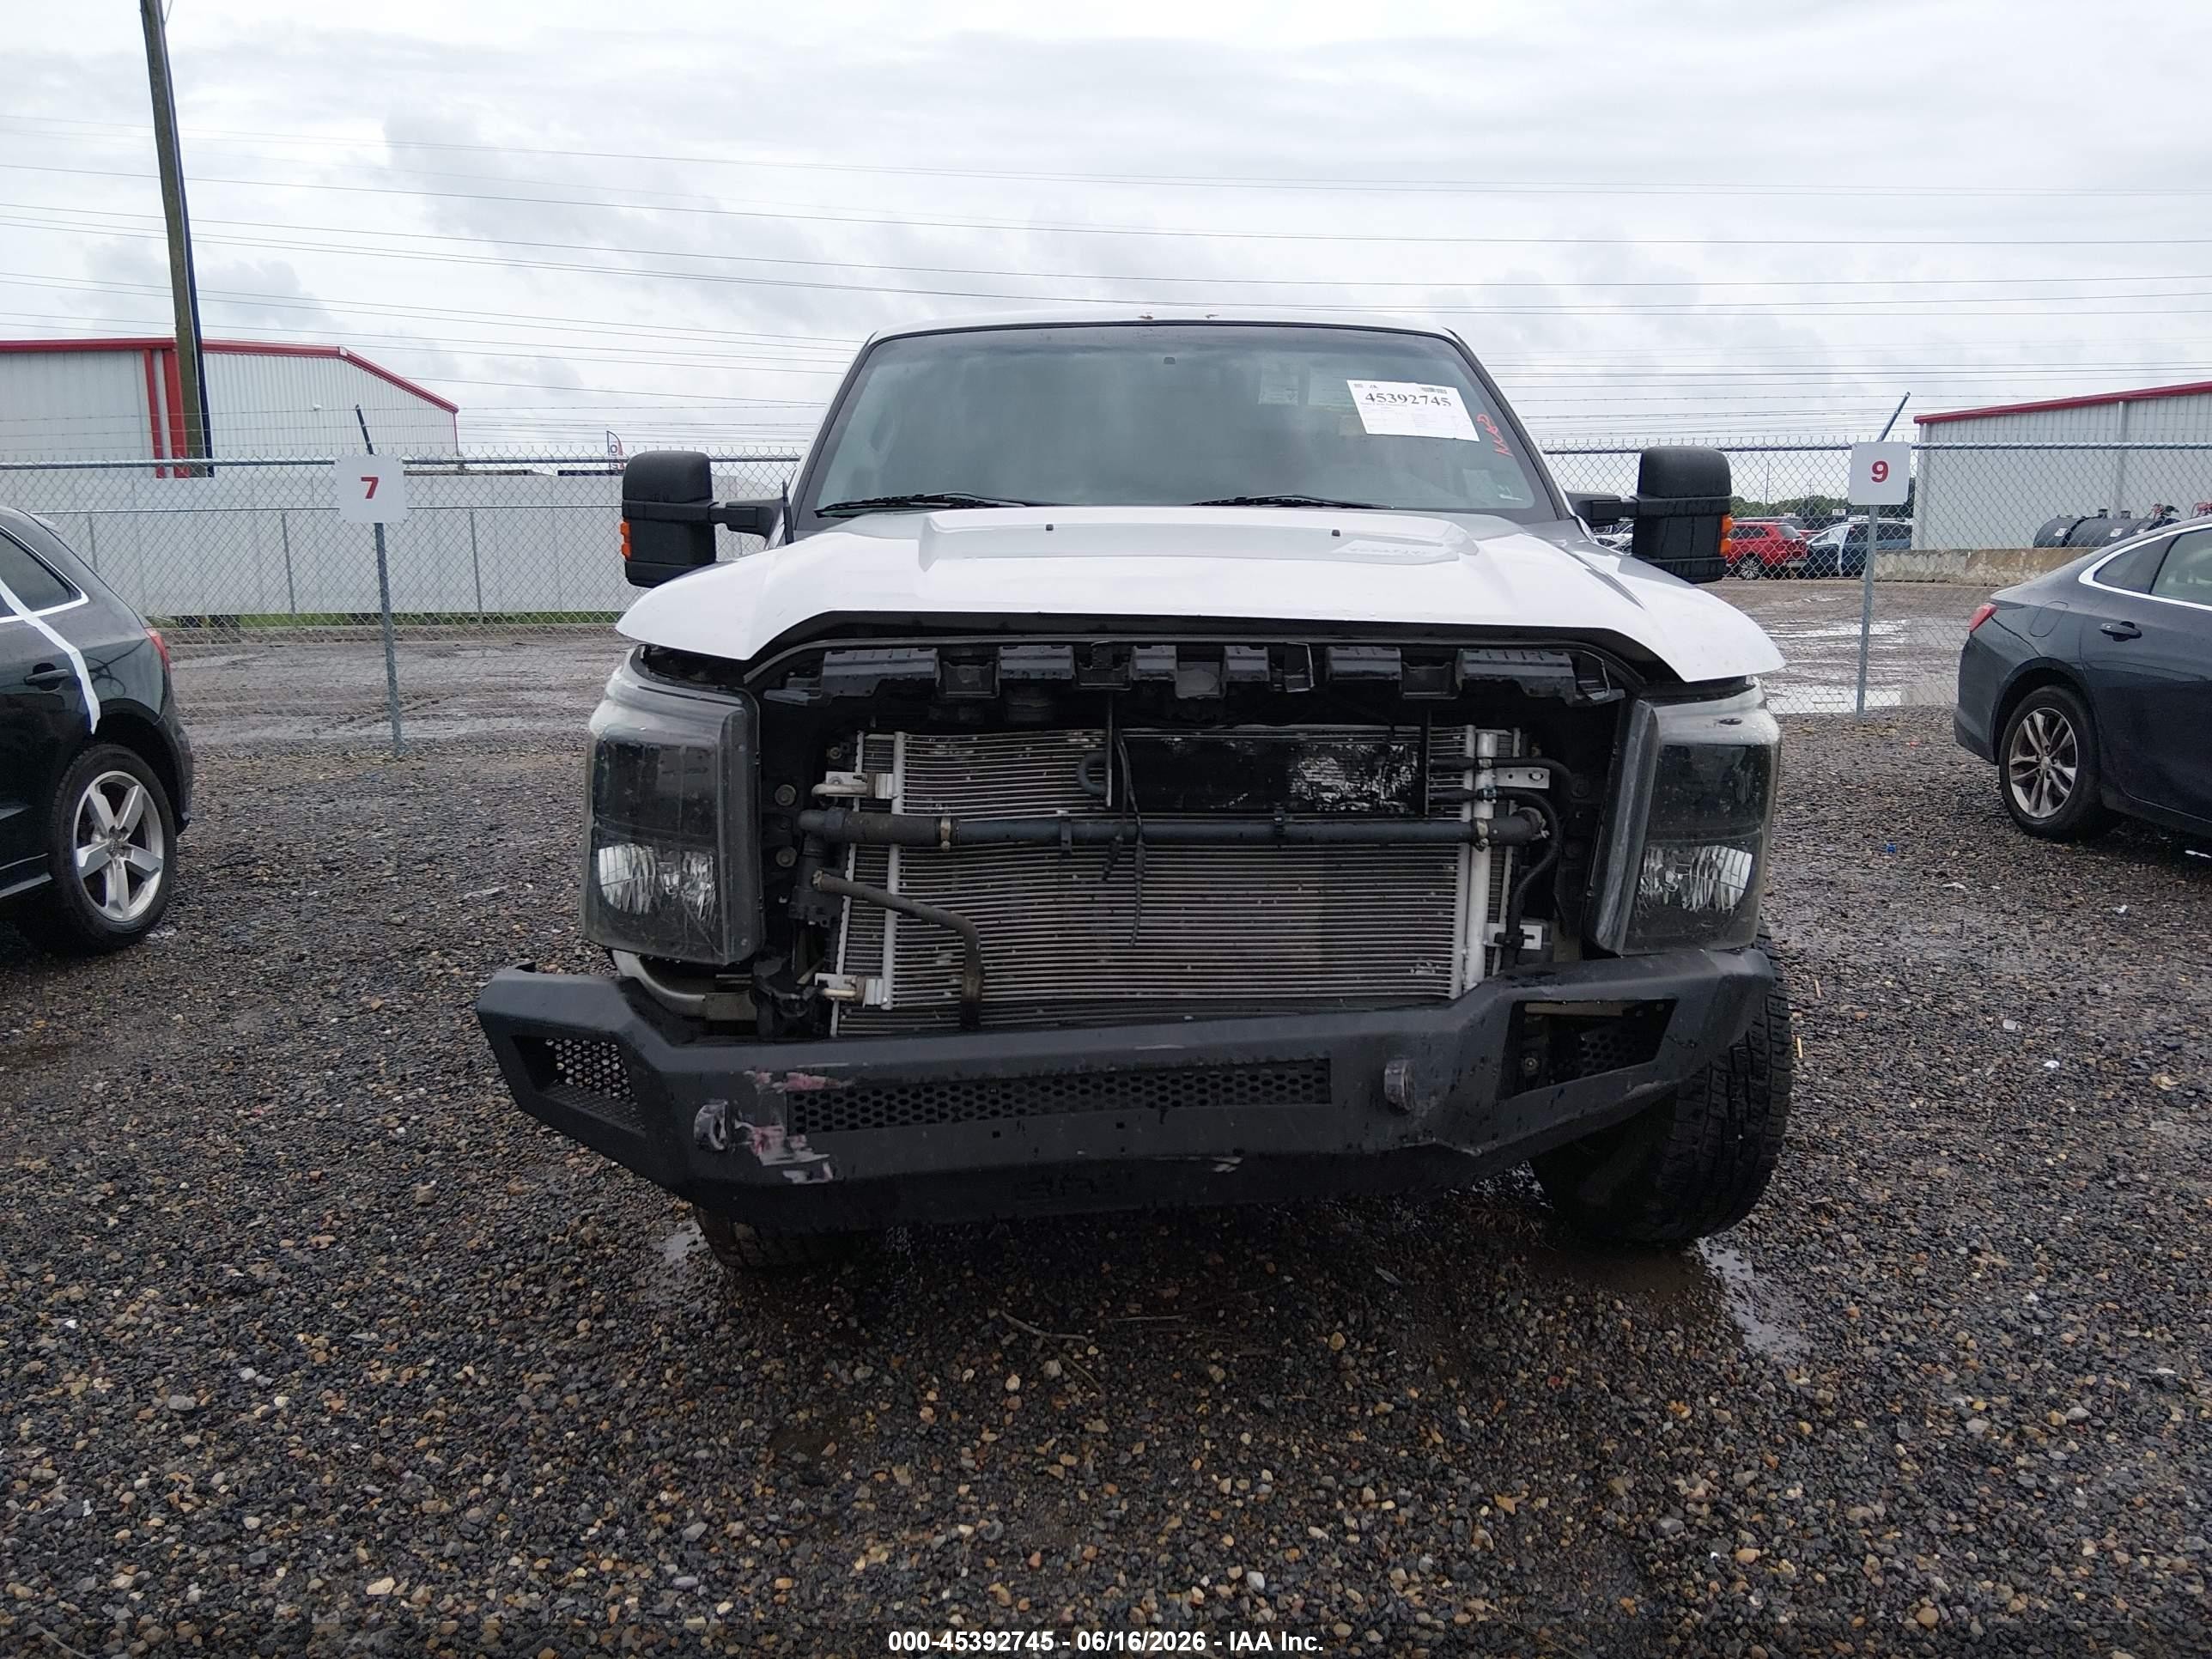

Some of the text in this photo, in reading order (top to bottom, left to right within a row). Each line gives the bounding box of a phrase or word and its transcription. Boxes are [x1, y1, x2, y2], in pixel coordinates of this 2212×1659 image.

[1364, 392, 1452, 407] 45392745
[1871, 460, 1889, 483] 9
[360, 476, 380, 500] 7
